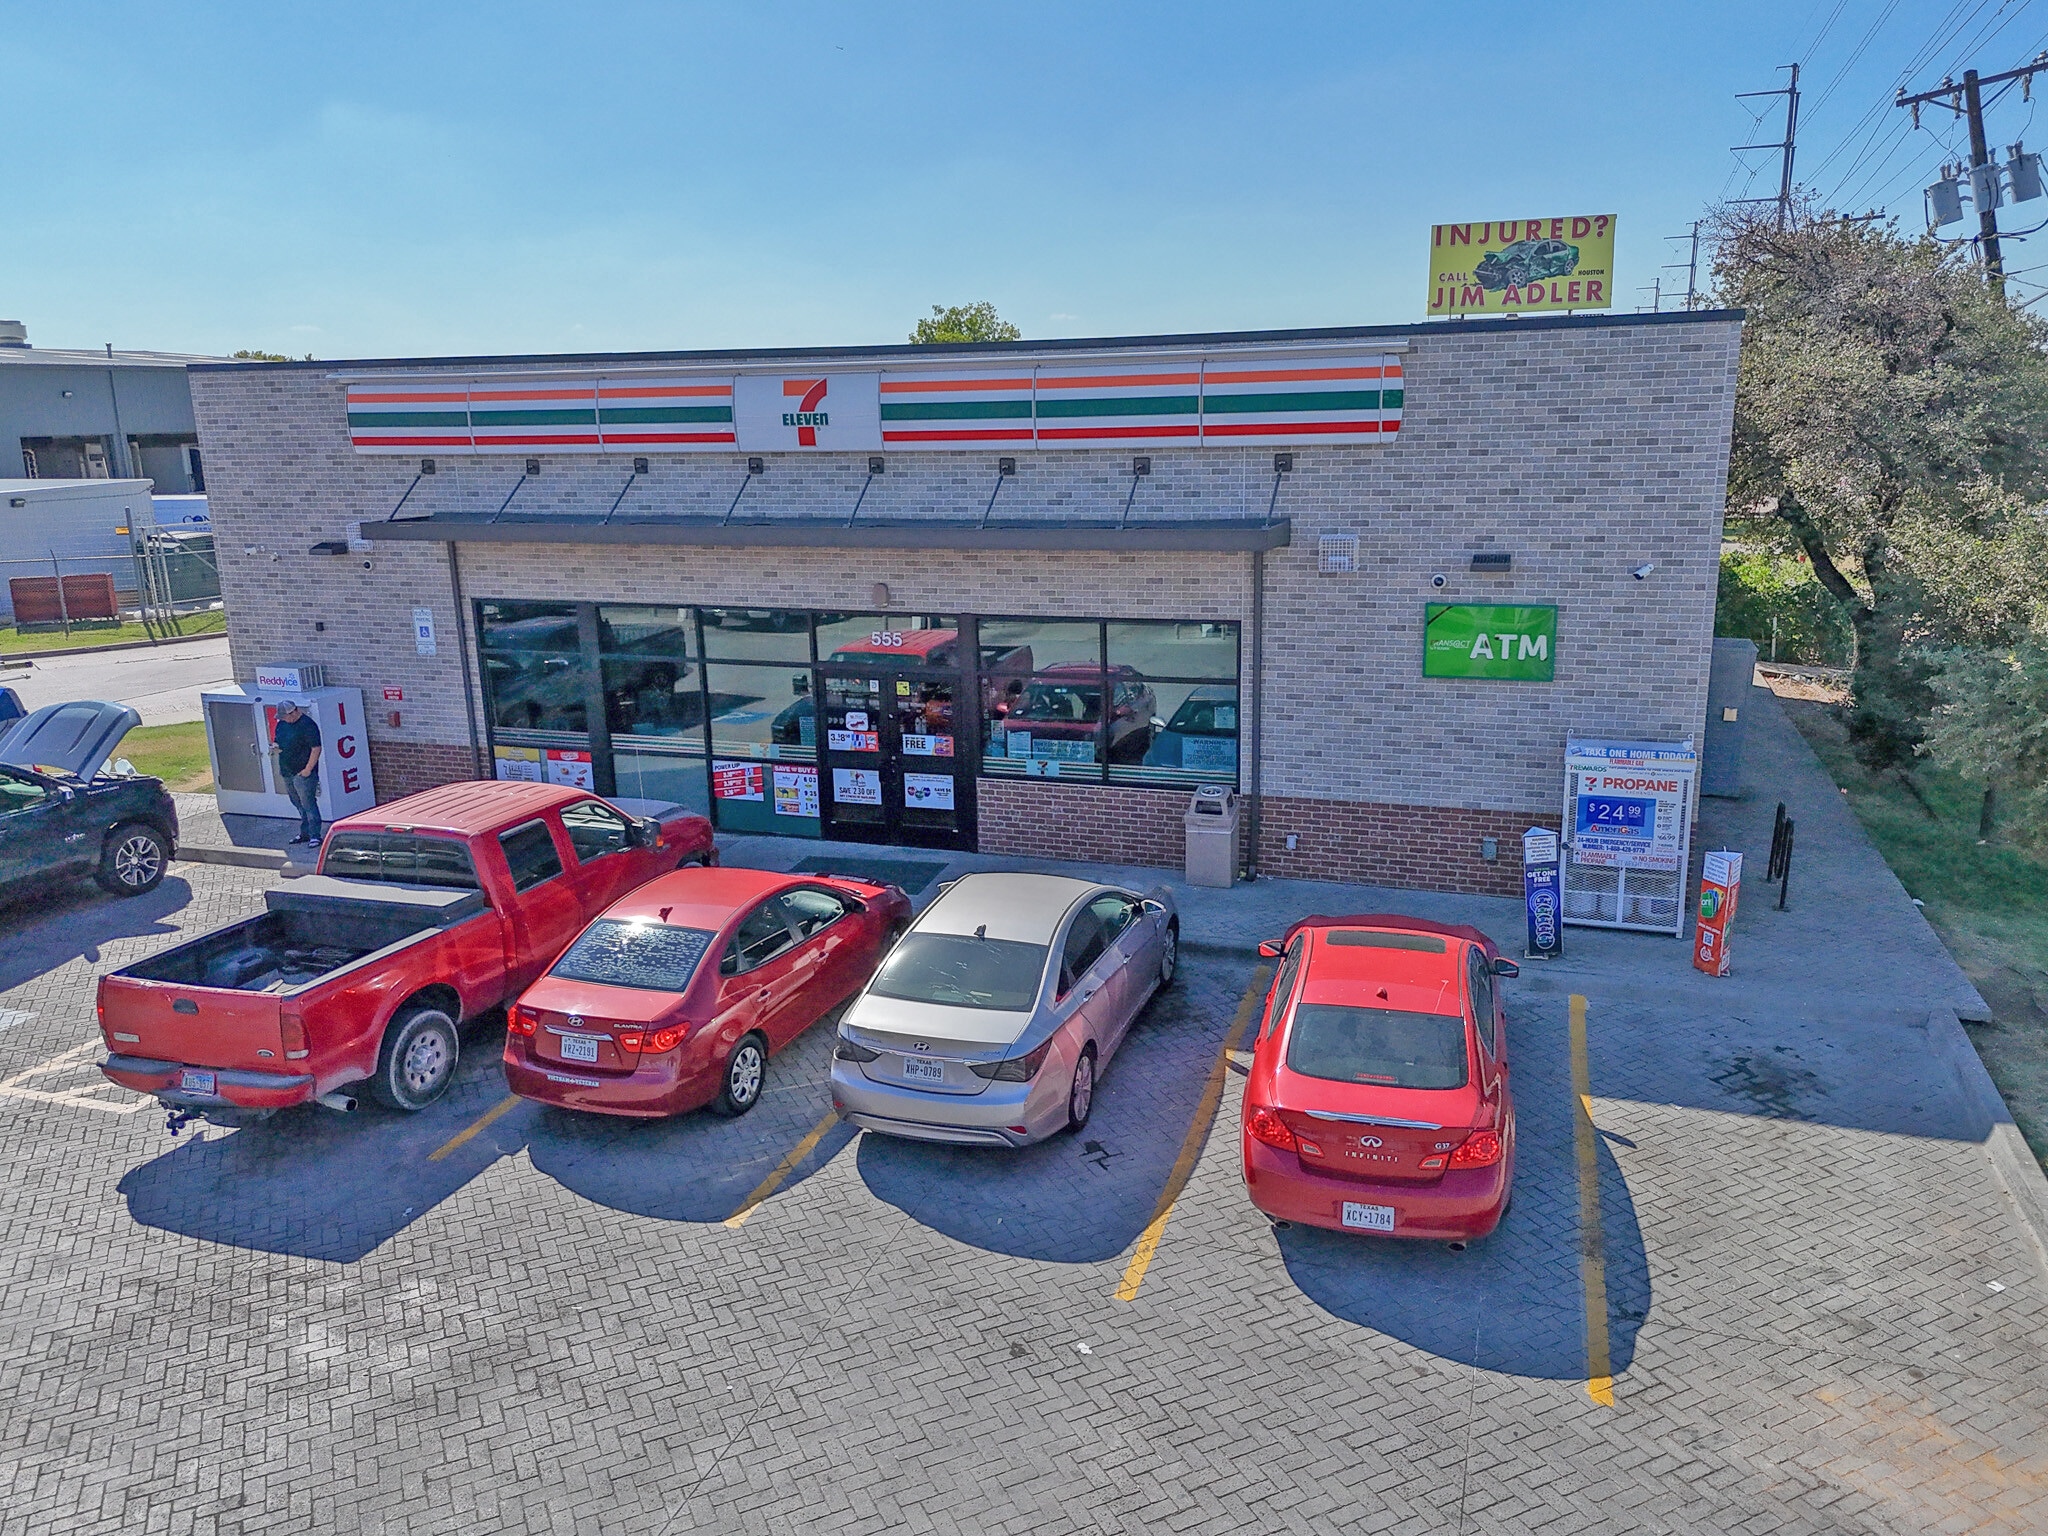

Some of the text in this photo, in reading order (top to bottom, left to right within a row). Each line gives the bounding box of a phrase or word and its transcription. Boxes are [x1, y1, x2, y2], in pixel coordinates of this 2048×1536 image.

[1435, 215, 1609, 247] INJURED?
[1439, 272, 1468, 282] CALL
[1432, 280, 1604, 309] JIM ADLER
[783, 378, 827, 446] 7
[871, 631, 903, 647] 555
[1469, 633, 1548, 661] ATM
[337, 702, 360, 794] ICE
[905, 740, 926, 750] FREE
[1584, 747, 1691, 760] TAKE ONE HOME TODAY!
[839, 786, 851, 794] SAVE
[866, 788, 876, 796] OFF
[1602, 777, 1678, 792] PROPANE
[1589, 803, 1595, 812] $
[1597, 804, 1624, 820] 24
[1628, 806, 1640, 814] 99
[1590, 823, 1639, 835] AmeriGas
[1580, 851, 1618, 860] FLAMMABLE
[1580, 857, 1607, 865] PROPANE
[1638, 855, 1676, 864] NO SMOKING
[1345, 1151, 1398, 1163] INFINITI
